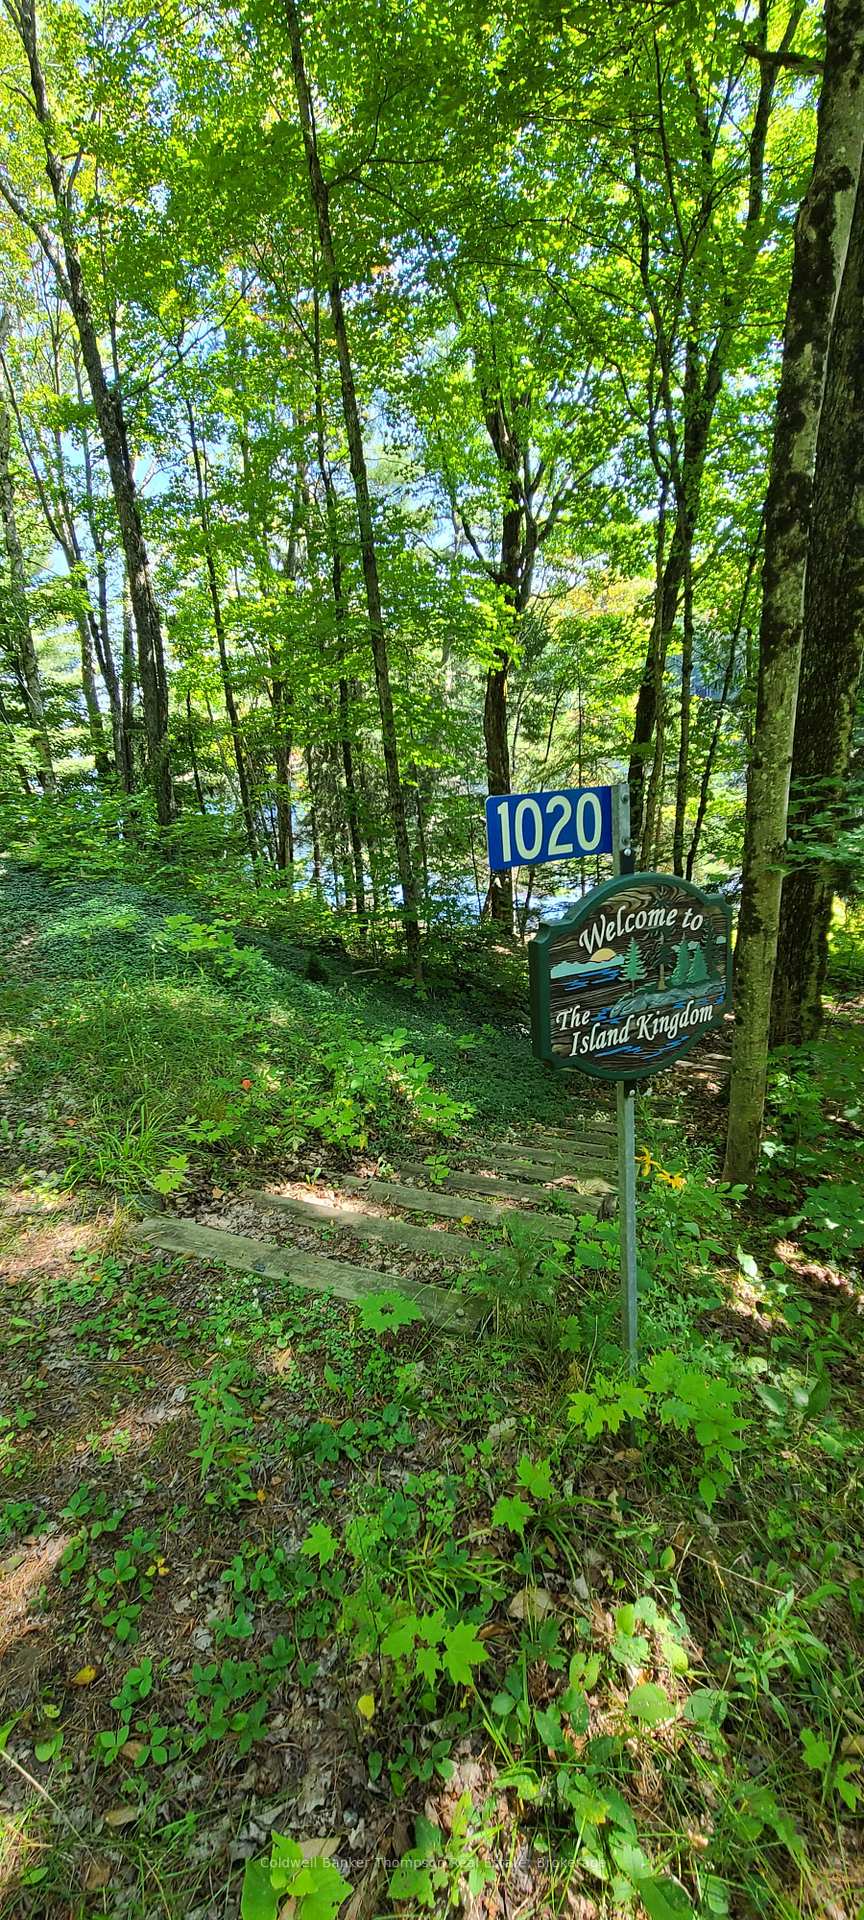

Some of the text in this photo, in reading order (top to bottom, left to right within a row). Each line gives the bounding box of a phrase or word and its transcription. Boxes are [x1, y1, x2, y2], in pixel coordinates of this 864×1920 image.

[497, 792, 602, 862] 1020
[579, 905, 704, 954] Welcome to
[556, 1005, 591, 1031] The
[569, 1000, 713, 1057] Island Kingdom
